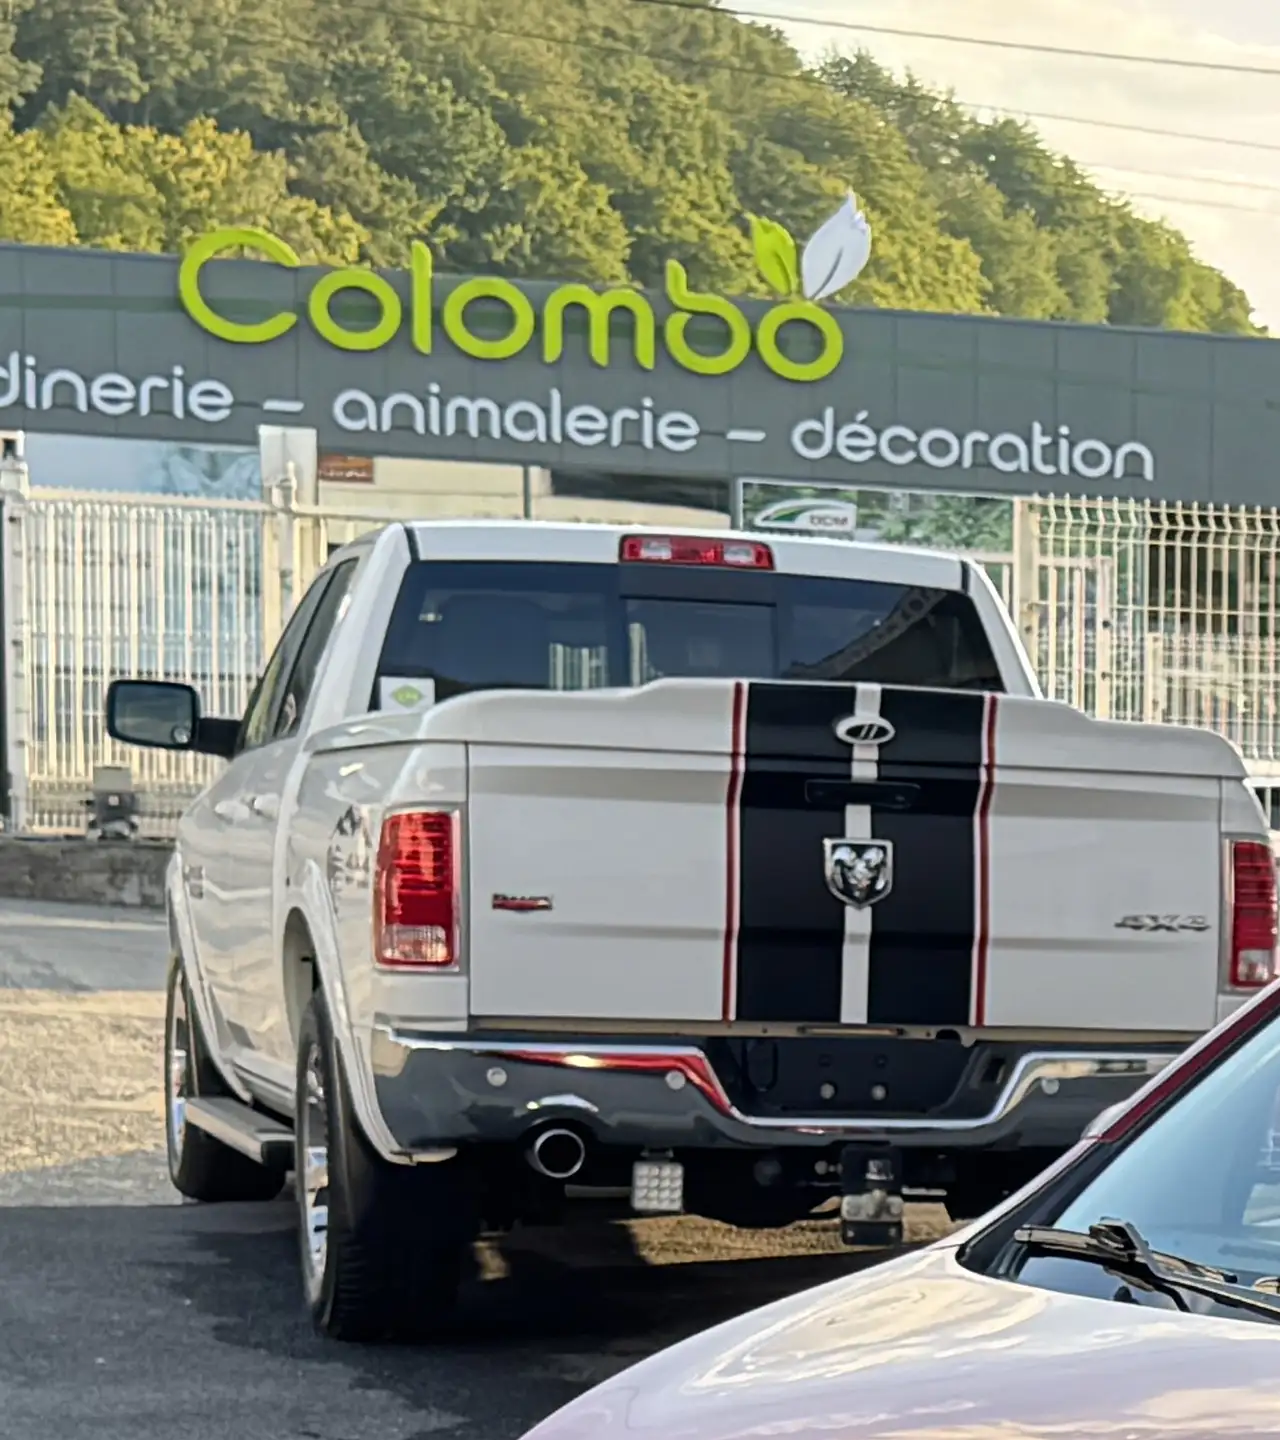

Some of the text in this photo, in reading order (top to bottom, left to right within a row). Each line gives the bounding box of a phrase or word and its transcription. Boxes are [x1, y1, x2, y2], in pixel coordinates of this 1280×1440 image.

[178, 227, 844, 381] Colombo
[331, 382, 701, 451] animalerie
[790, 406, 1155, 481] décoration
